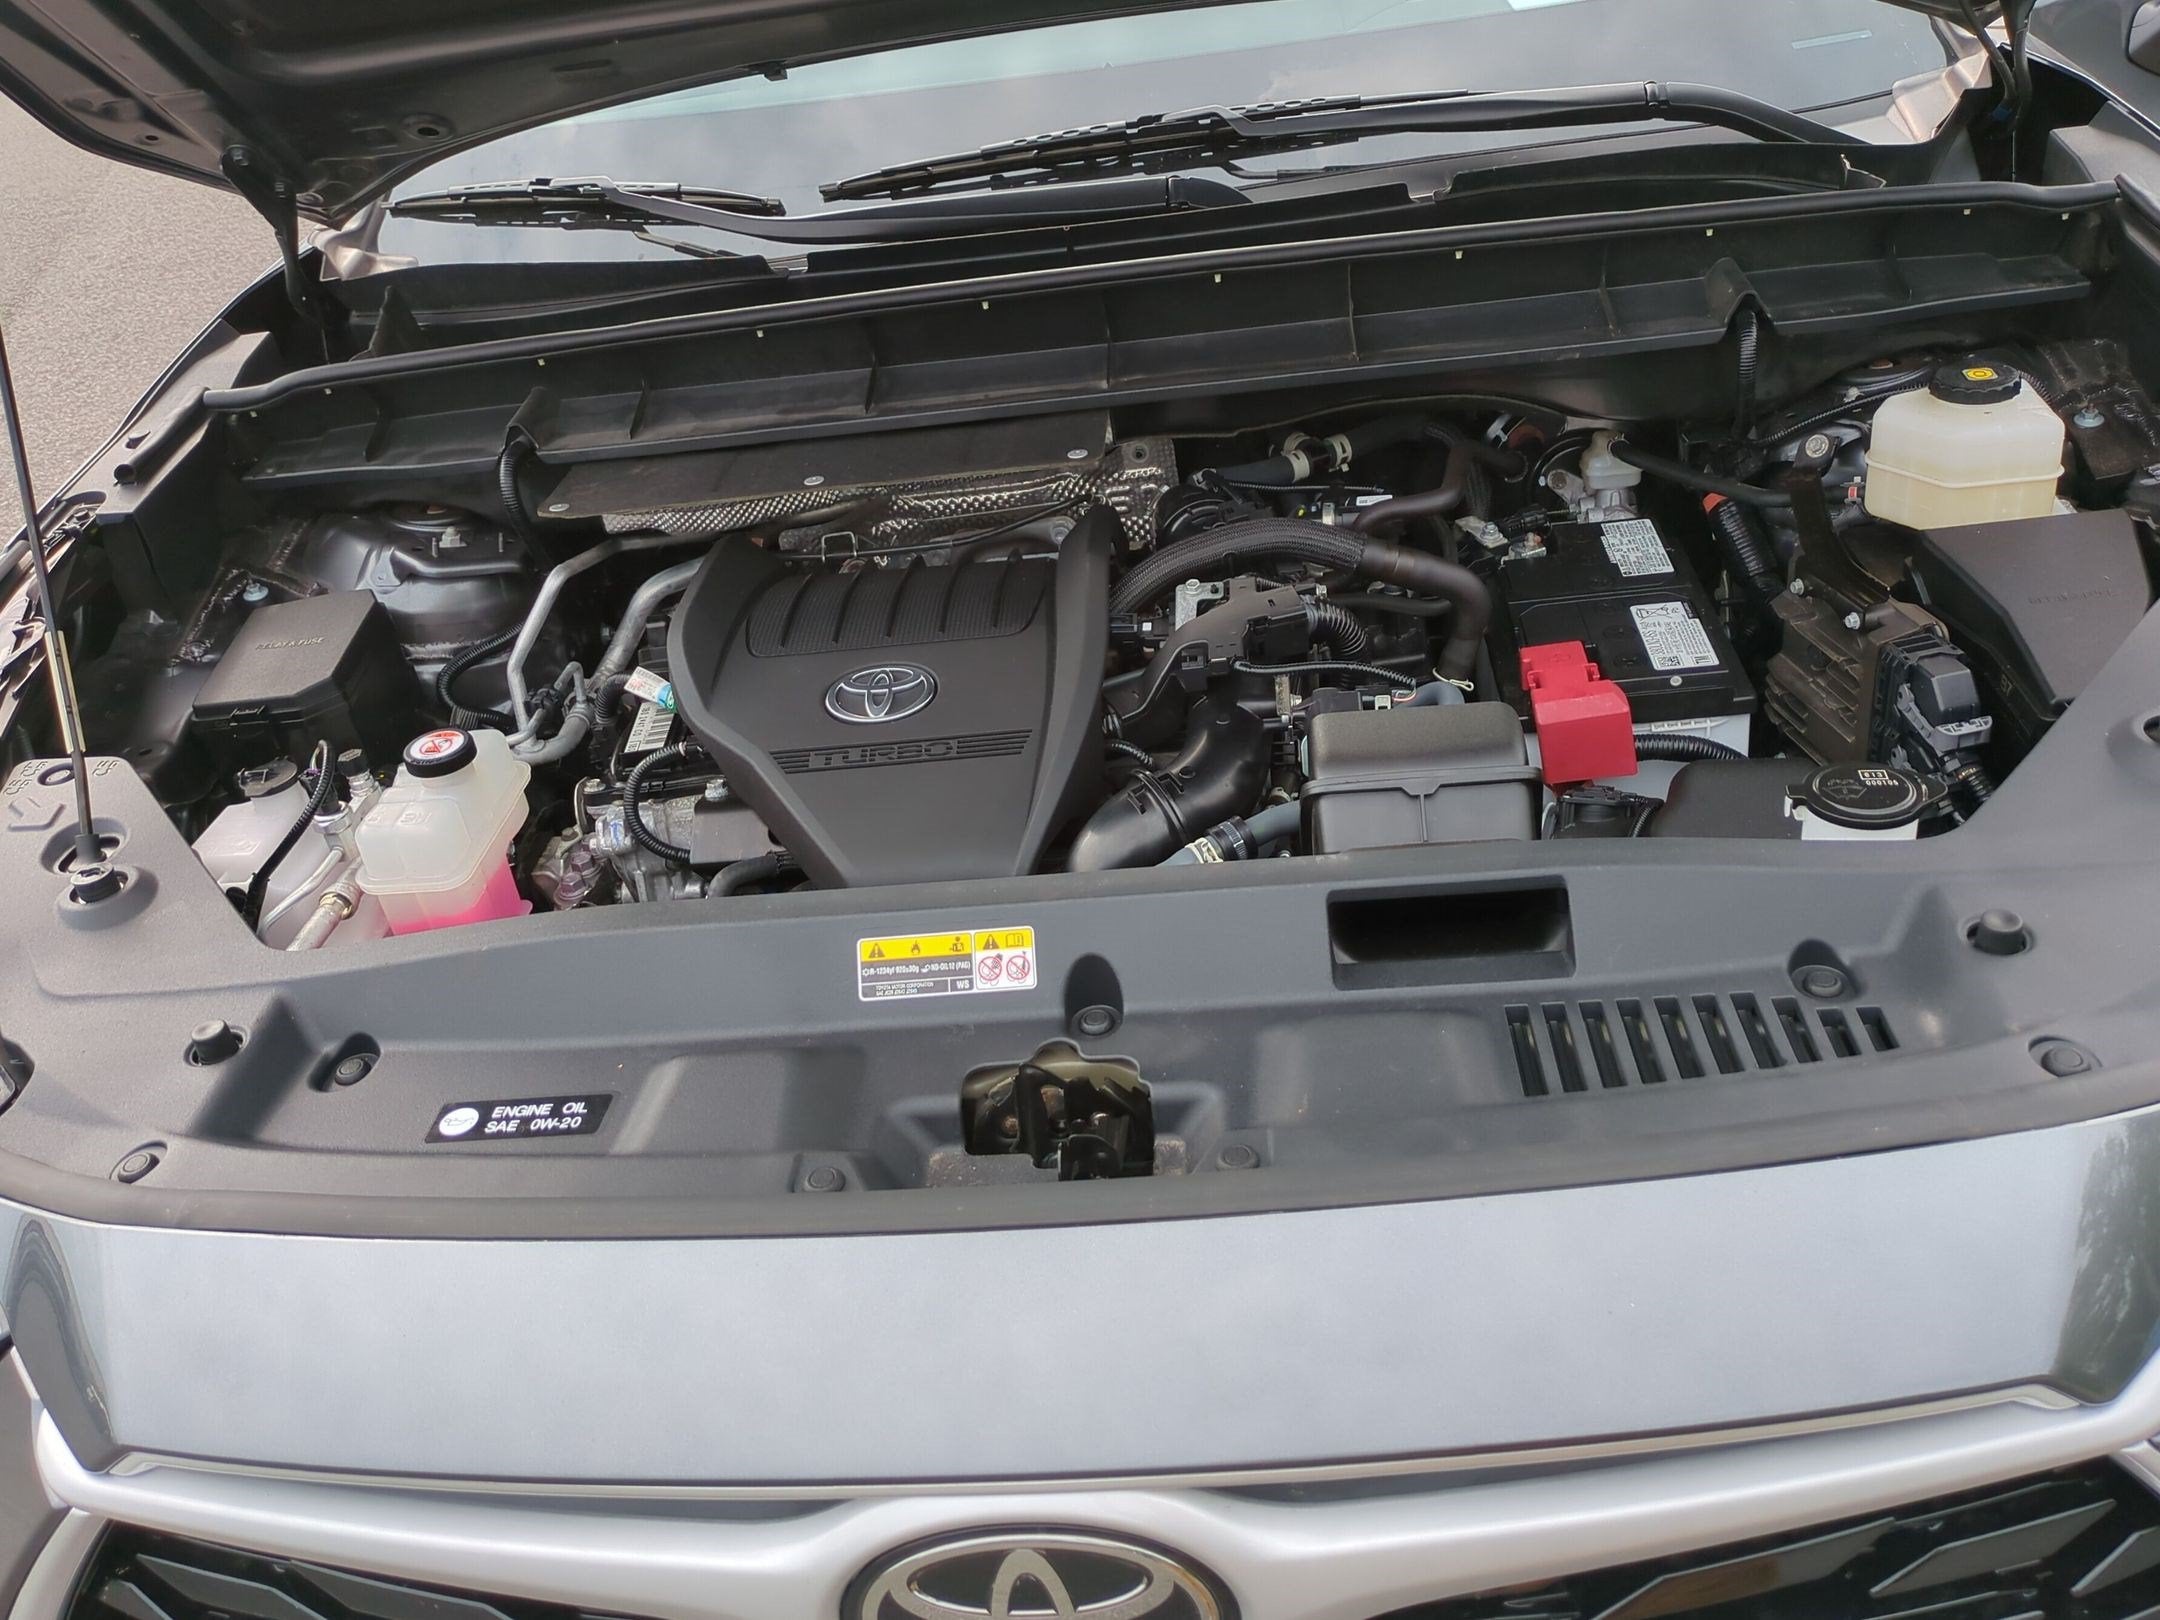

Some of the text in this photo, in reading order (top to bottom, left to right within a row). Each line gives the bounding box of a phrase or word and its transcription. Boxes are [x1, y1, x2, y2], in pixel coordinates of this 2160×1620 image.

[812, 741, 955, 767] TURBO
[956, 979, 970, 989] WS
[491, 1101, 588, 1118] ENGINE OIL
[484, 1120, 520, 1133] SAE
